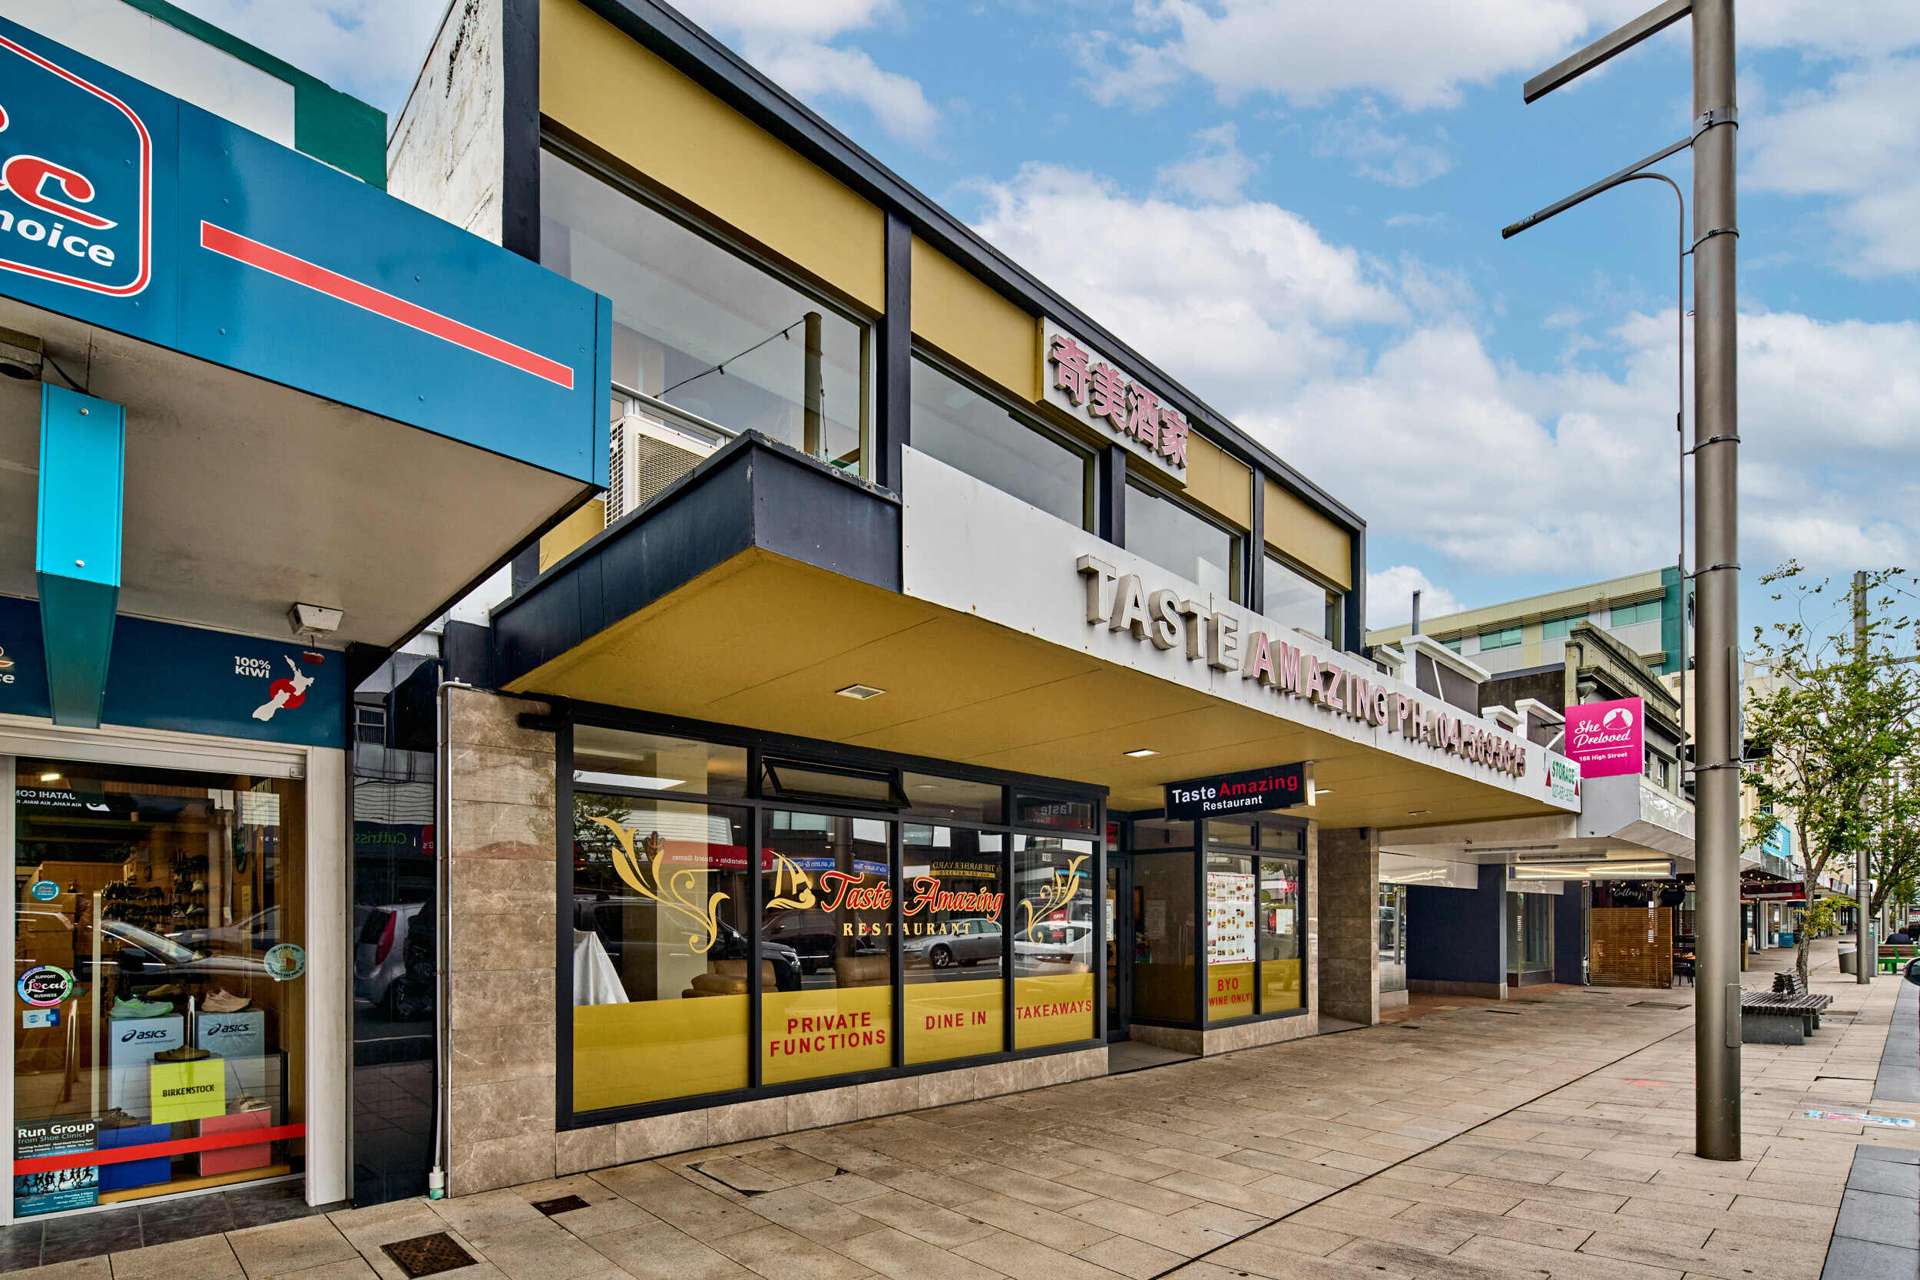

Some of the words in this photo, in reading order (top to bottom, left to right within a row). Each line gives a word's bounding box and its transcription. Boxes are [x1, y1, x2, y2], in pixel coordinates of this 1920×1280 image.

[0, 209, 115, 267] oice
[1048, 333, 1189, 470] 奇美酒家
[1077, 553, 1239, 672] TASTE
[1242, 632, 1389, 726] AMAZING
[234, 655, 271, 669] 100%
[235, 665, 269, 678] KIWI
[1574, 720, 1601, 734] She
[1573, 729, 1632, 748] Preloved
[1172, 787, 1217, 804] Taste
[1219, 775, 1298, 798] Amazing
[1203, 795, 1263, 811] Restaurant
[820, 870, 893, 912] Taste
[903, 875, 1005, 923] Amazing
[843, 922, 971, 936] RESTAURANT
[26, 979, 67, 994] Local
[1217, 977, 1239, 992] BYO
[1208, 995, 1228, 1006] WINE
[1016, 999, 1092, 1021] TAKEAWAYS
[787, 1011, 871, 1034] PRIVATE
[925, 1012, 964, 1030] DINE
[972, 1010, 987, 1026] IN
[136, 1029, 168, 1040] asics
[221, 1023, 250, 1033] asics
[770, 1029, 886, 1057] FUNCTIONS
[162, 1084, 215, 1098] BIRKENSTOCK
[18, 1128, 46, 1138] Run
[50, 1123, 95, 1134] Group
